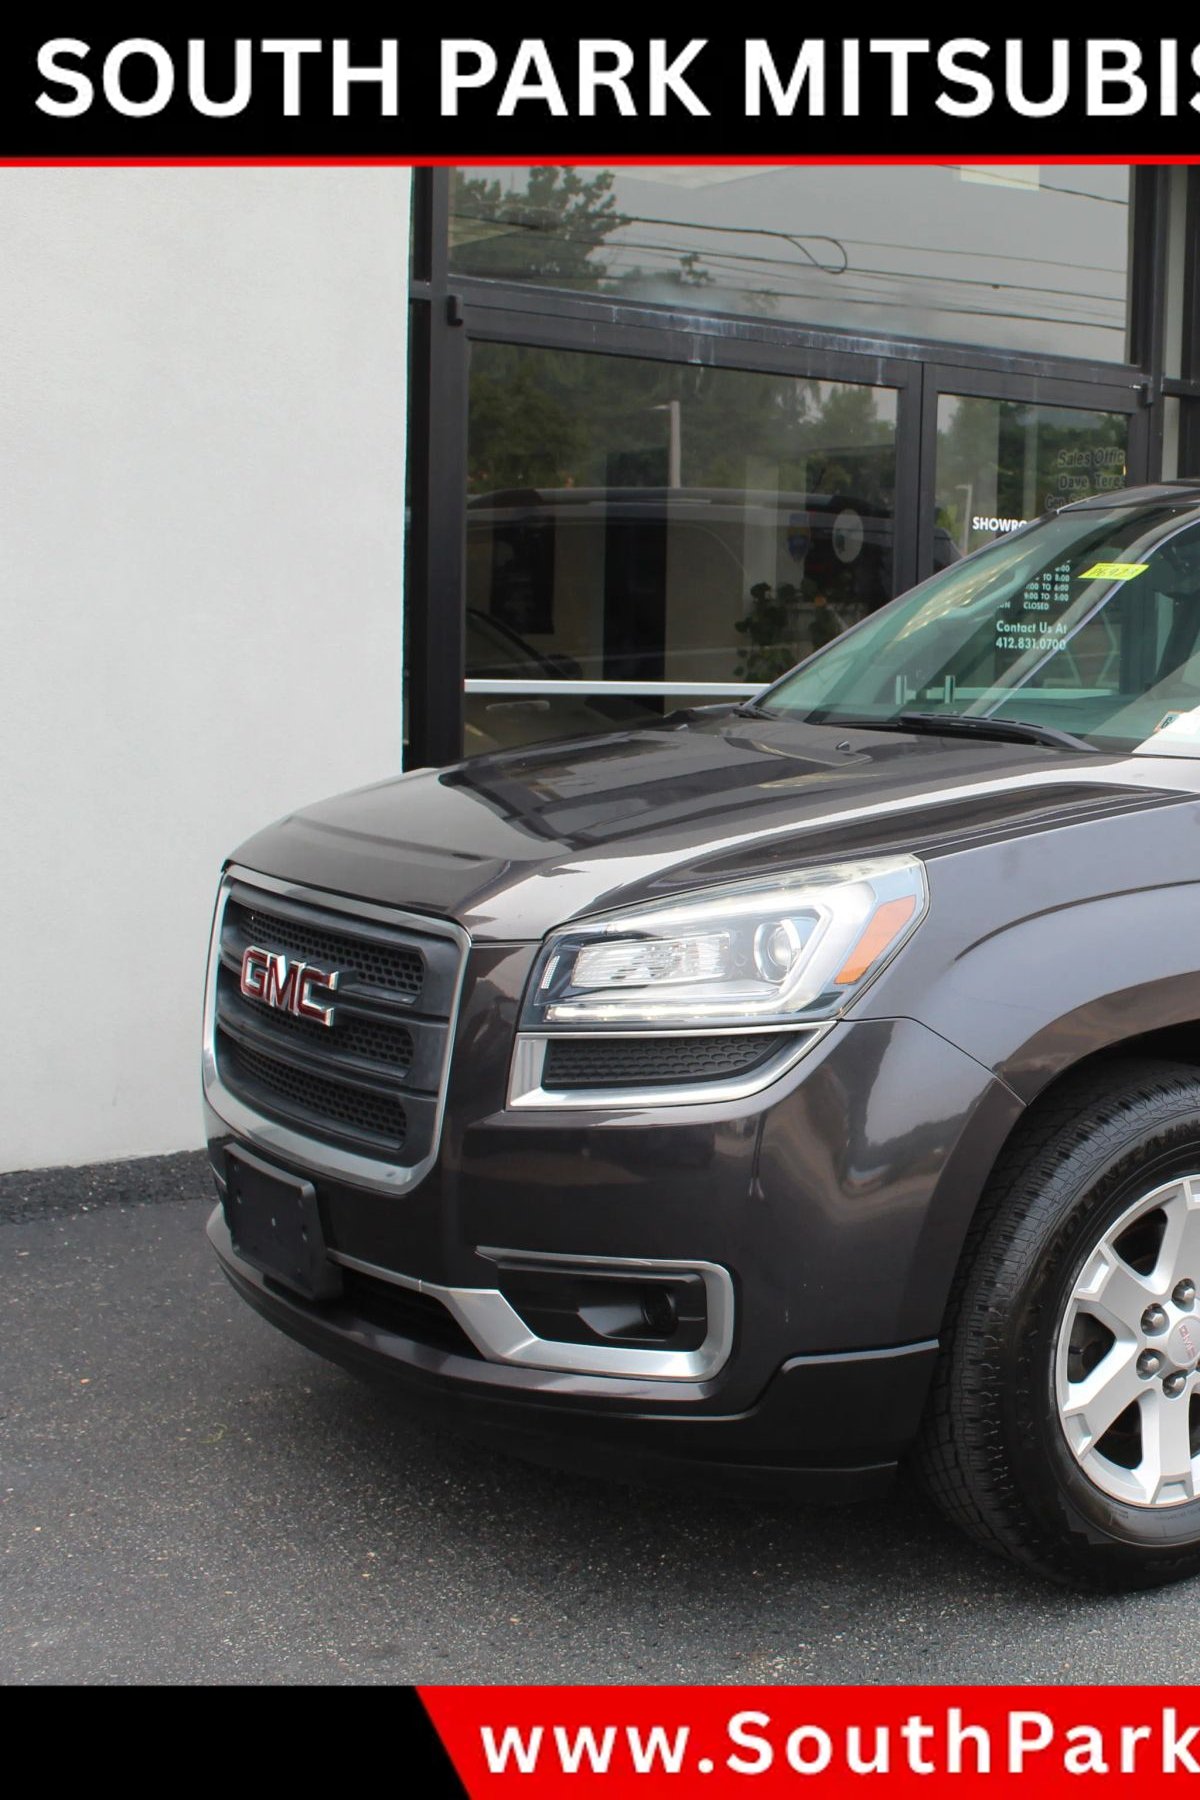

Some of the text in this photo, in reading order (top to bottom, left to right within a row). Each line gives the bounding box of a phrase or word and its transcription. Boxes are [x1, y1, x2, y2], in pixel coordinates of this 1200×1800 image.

[1058, 449, 1090, 467] Sales
[1023, 602, 1049, 610] CLOSED
[996, 620, 1067, 634] Contact Us At
[996, 637, 1067, 650] 412.831.0700
[241, 945, 339, 1027] GMC
